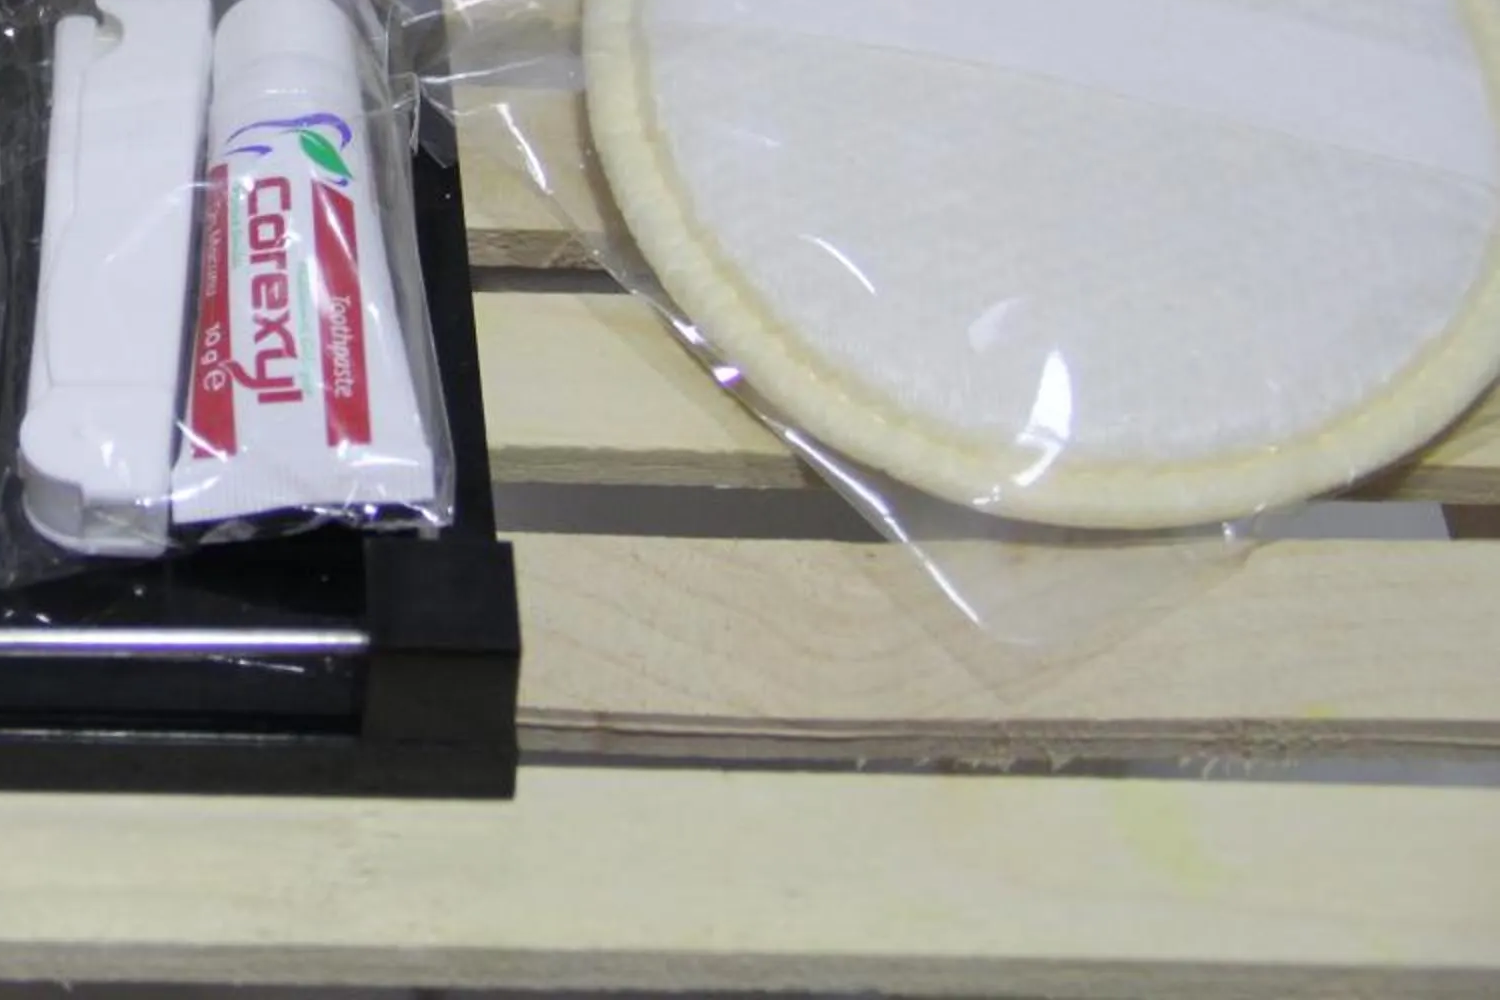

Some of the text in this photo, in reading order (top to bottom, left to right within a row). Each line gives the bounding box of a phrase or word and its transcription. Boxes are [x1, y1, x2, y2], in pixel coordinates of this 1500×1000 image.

[205, 321, 221, 346] 10
[224, 176, 304, 404] Corexyl
[329, 295, 353, 398] Toothpaste
